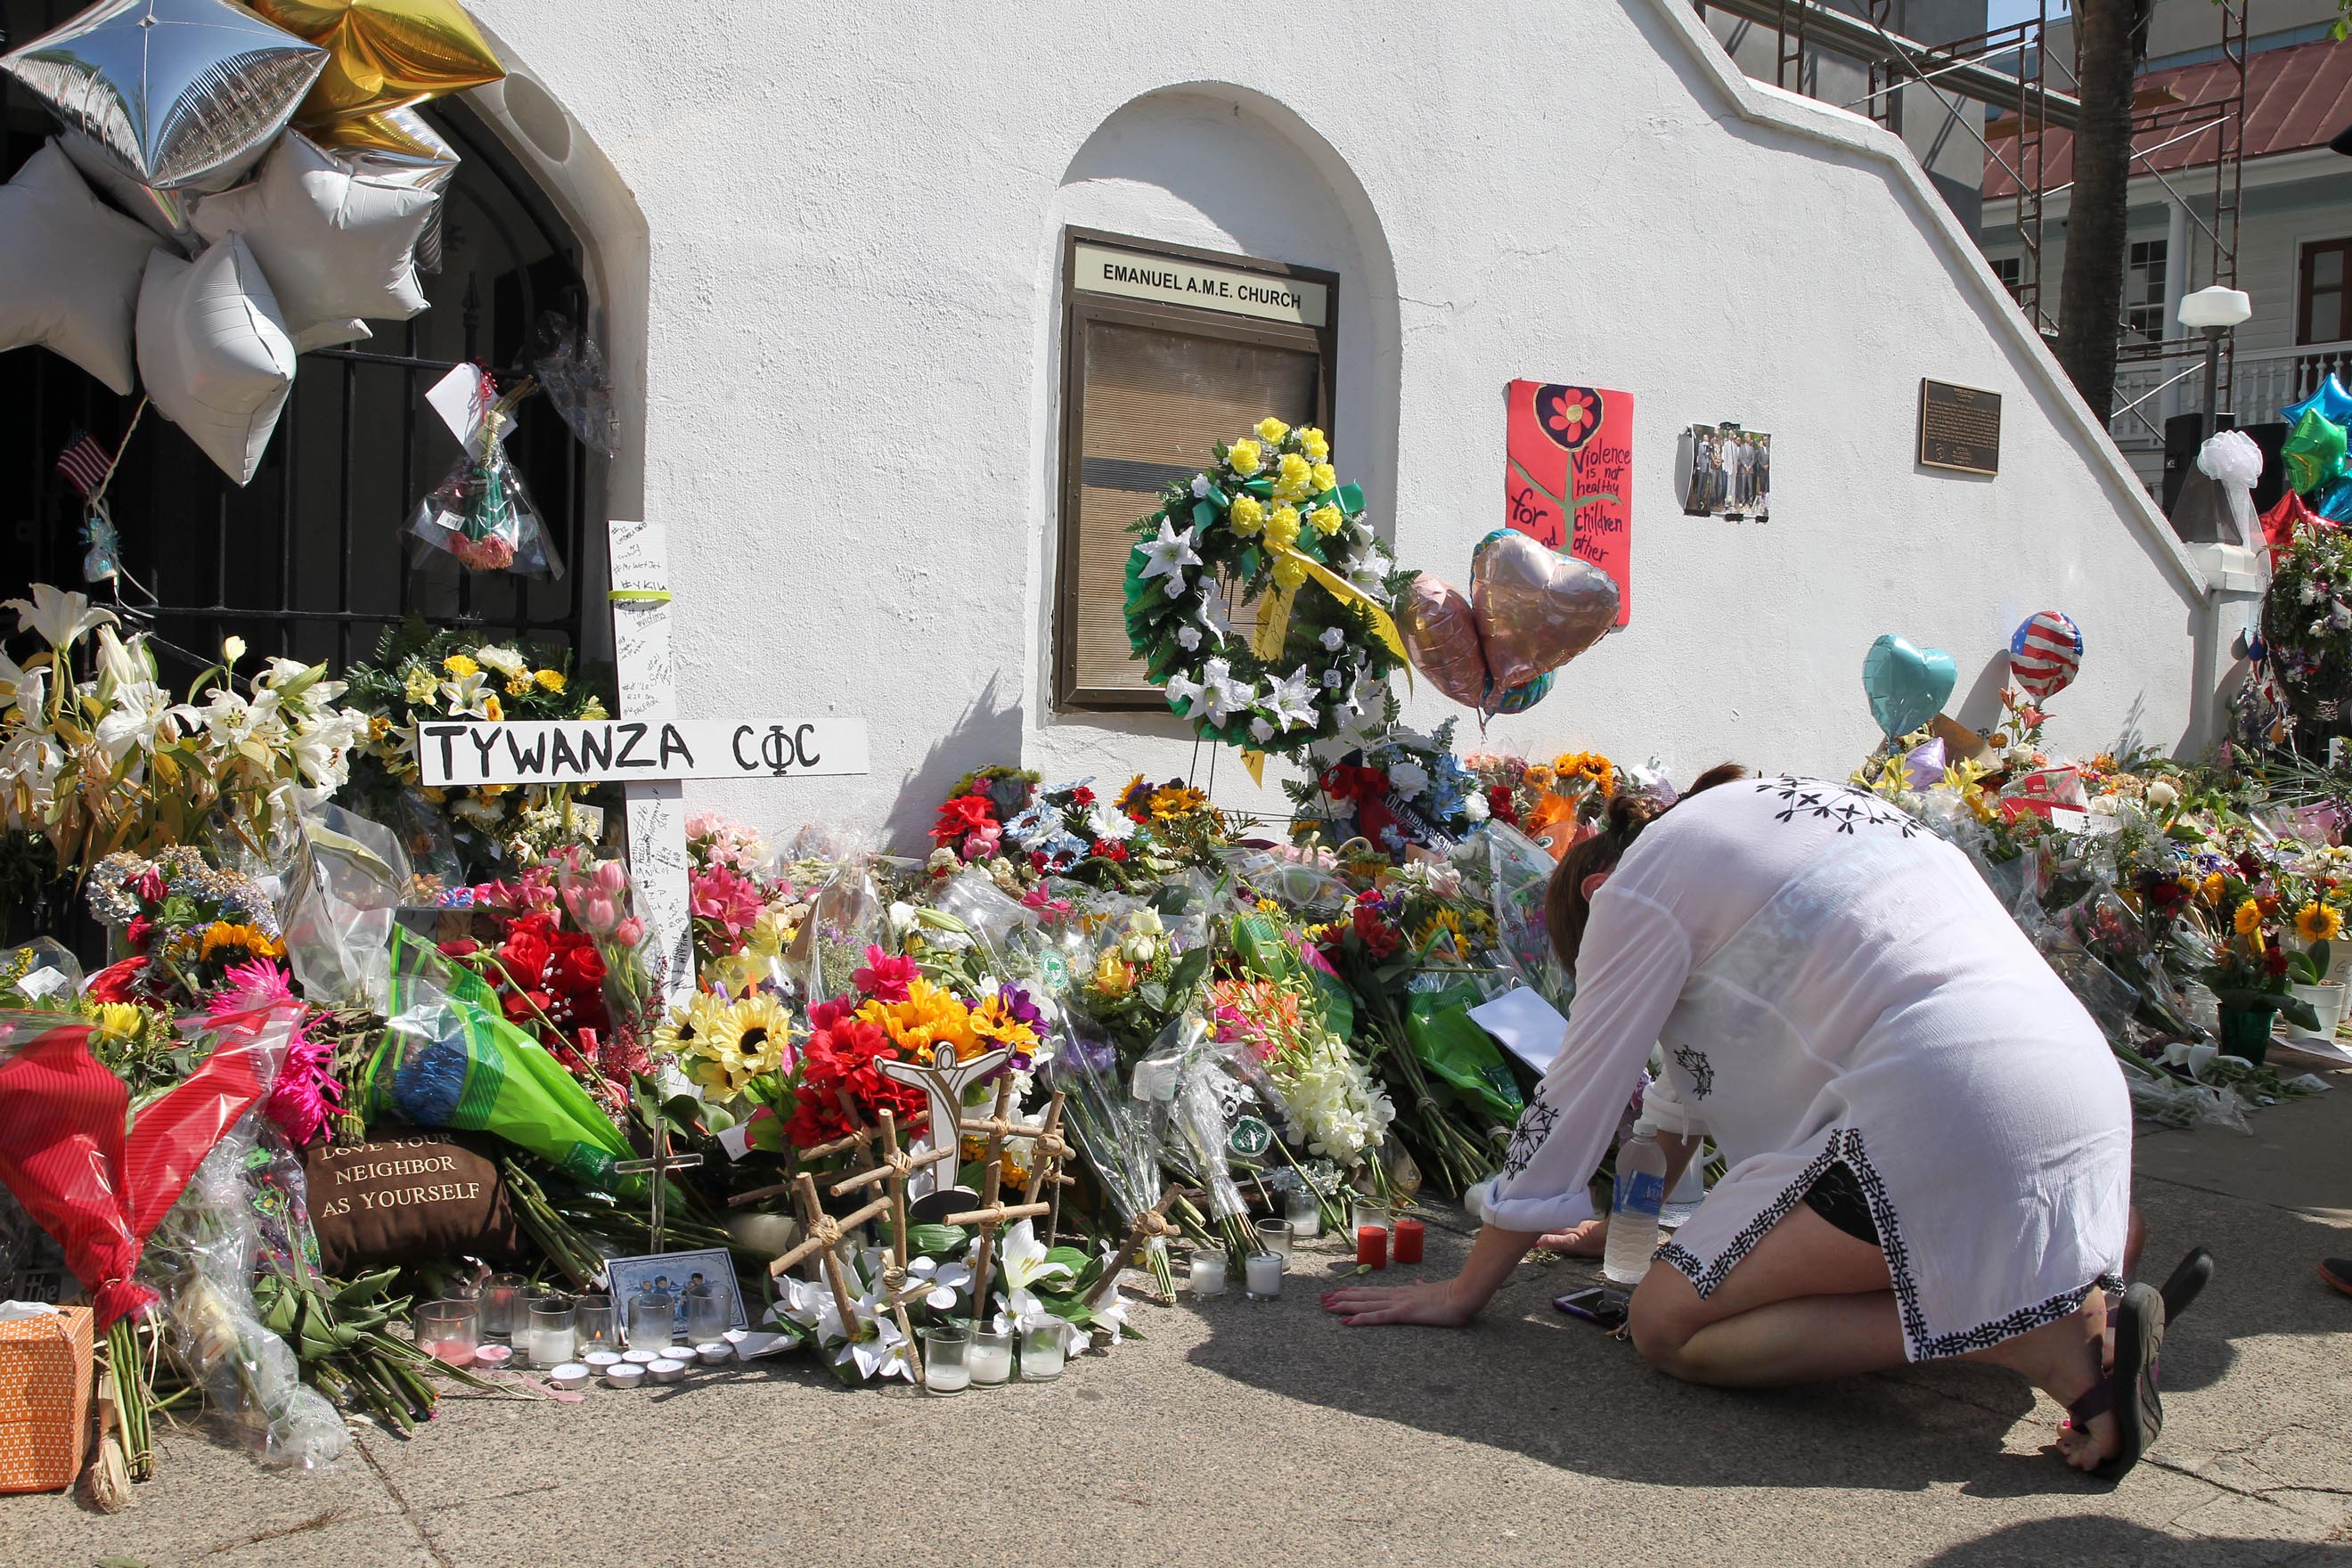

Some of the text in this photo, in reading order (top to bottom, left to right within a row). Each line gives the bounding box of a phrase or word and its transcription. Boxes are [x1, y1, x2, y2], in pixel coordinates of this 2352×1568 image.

[1103, 264, 1302, 309] EMANUEL A.M.E. CHURCH
[1572, 438, 1632, 474] Violence
[1586, 465, 1625, 481] is not
[1511, 487, 1548, 527] for
[1576, 478, 1620, 504] healthy
[1573, 502, 1623, 536] children
[1572, 535, 1610, 563] other
[424, 723, 694, 780] TYWANZA
[321, 1132, 456, 1161] LOVE YOUR
[334, 1156, 457, 1187] NEIGHBOR
[321, 1181, 481, 1219] AS YOURSELF
